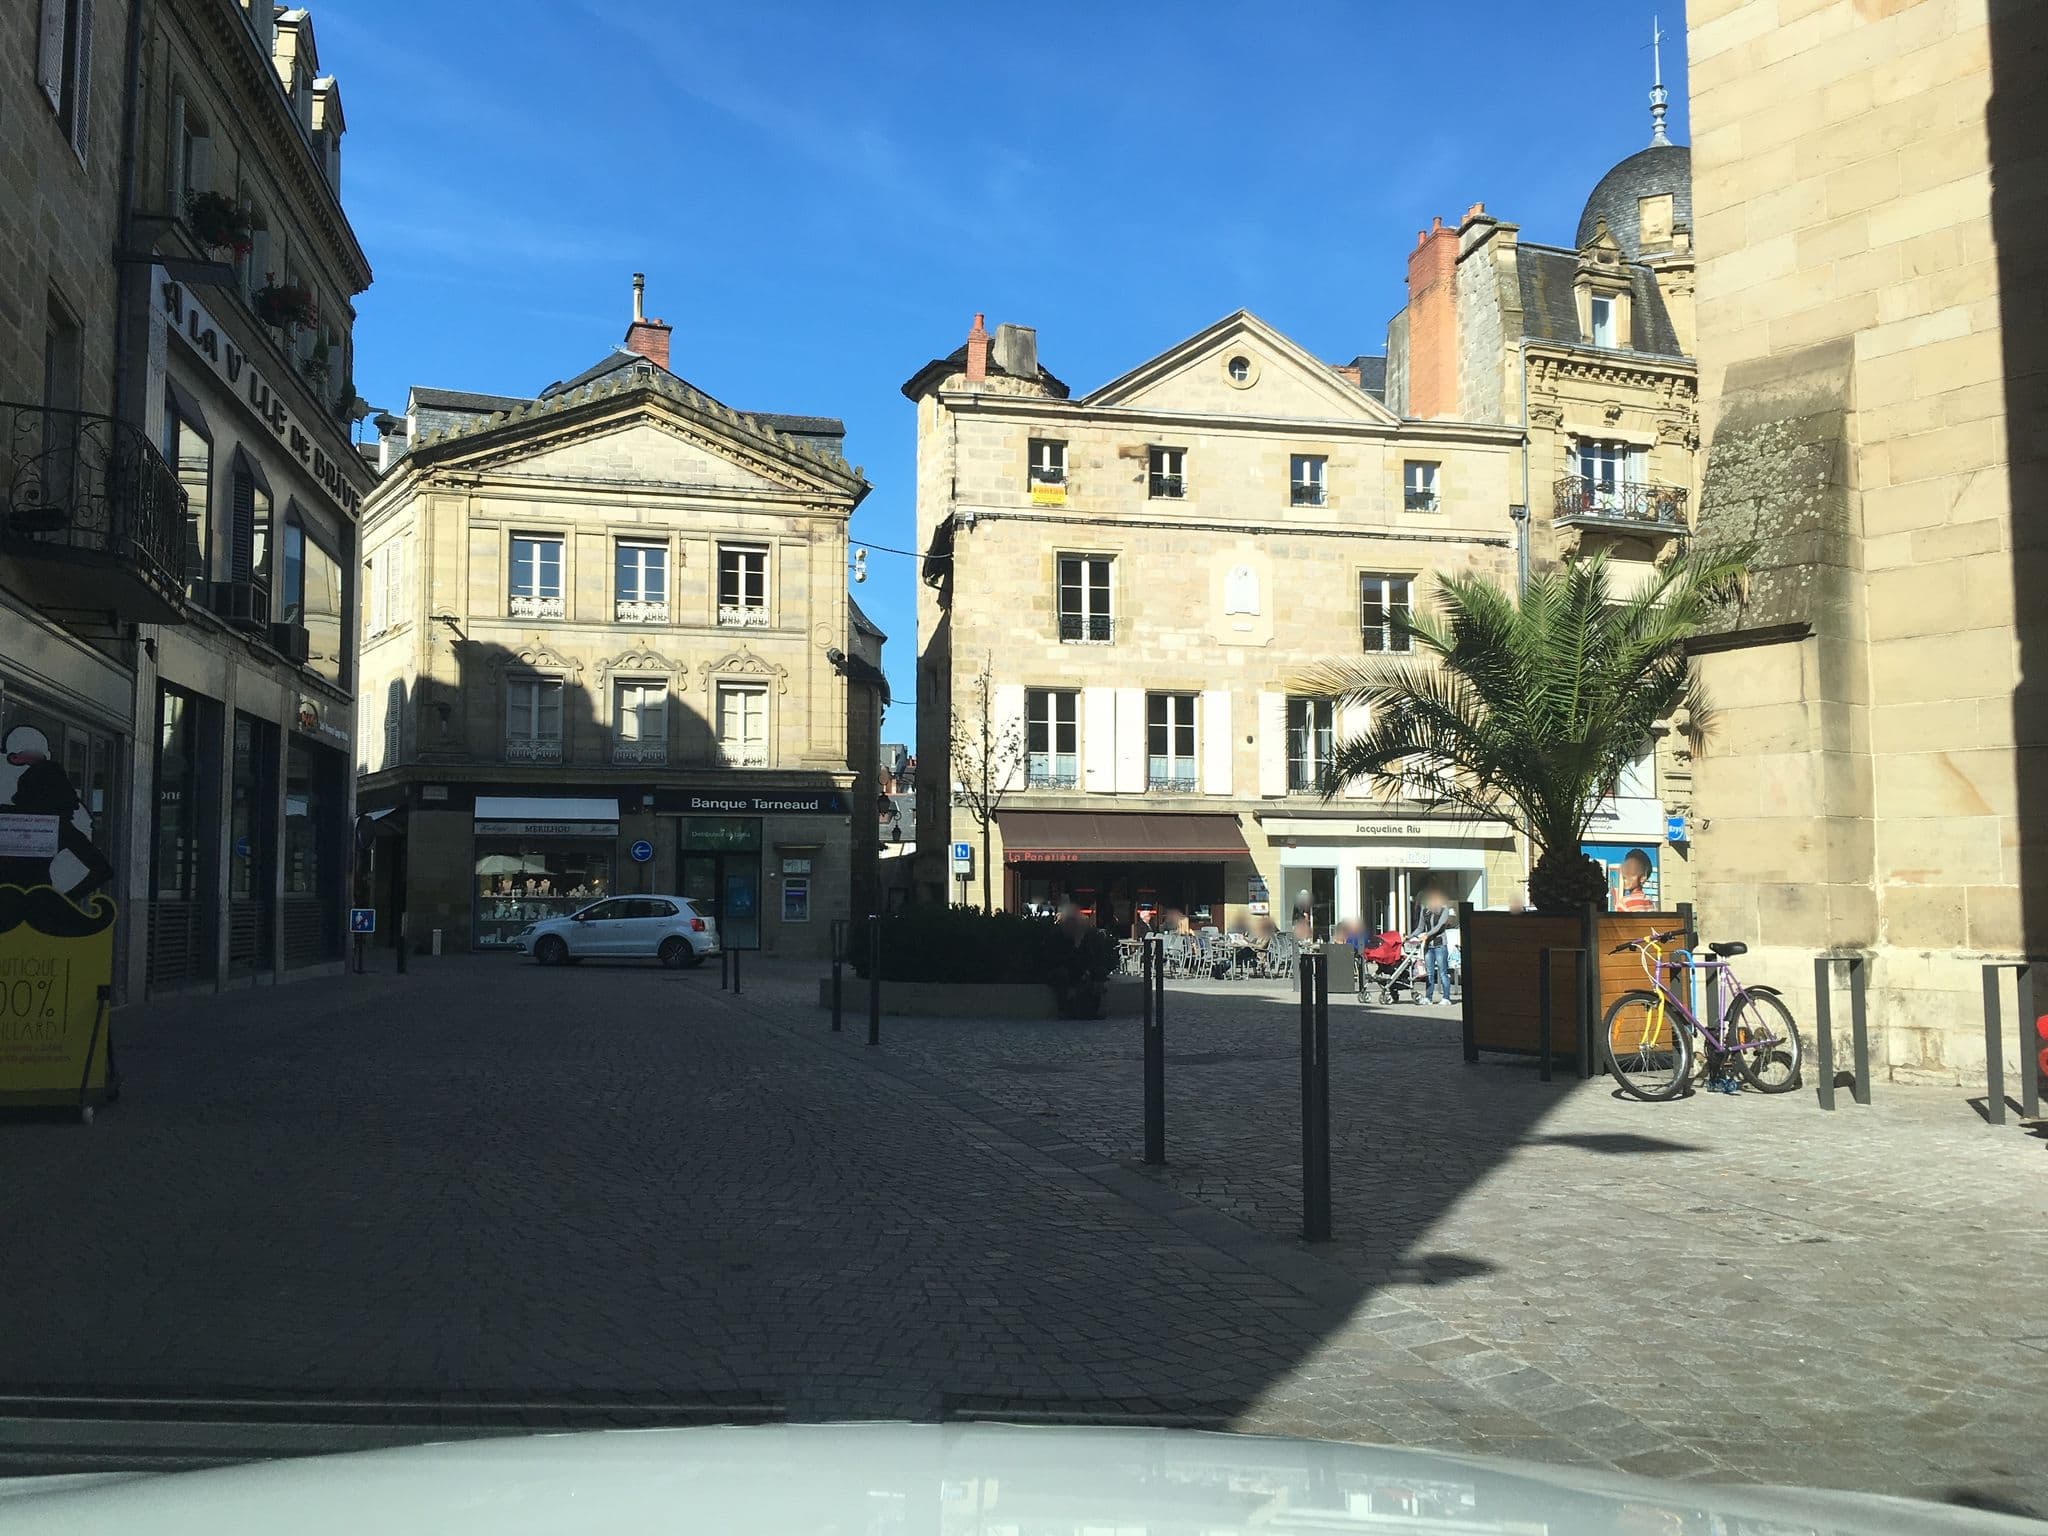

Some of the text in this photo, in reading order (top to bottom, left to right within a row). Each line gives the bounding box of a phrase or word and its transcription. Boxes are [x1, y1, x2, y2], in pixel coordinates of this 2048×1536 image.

[190, 309, 219, 362] LA
[226, 343, 288, 435] VLLE
[290, 425, 310, 463] DE
[691, 797, 819, 811] Banque Tarneaud
[1356, 824, 1421, 835] Jacqueline Riu
[1008, 852, 1021, 862] La
